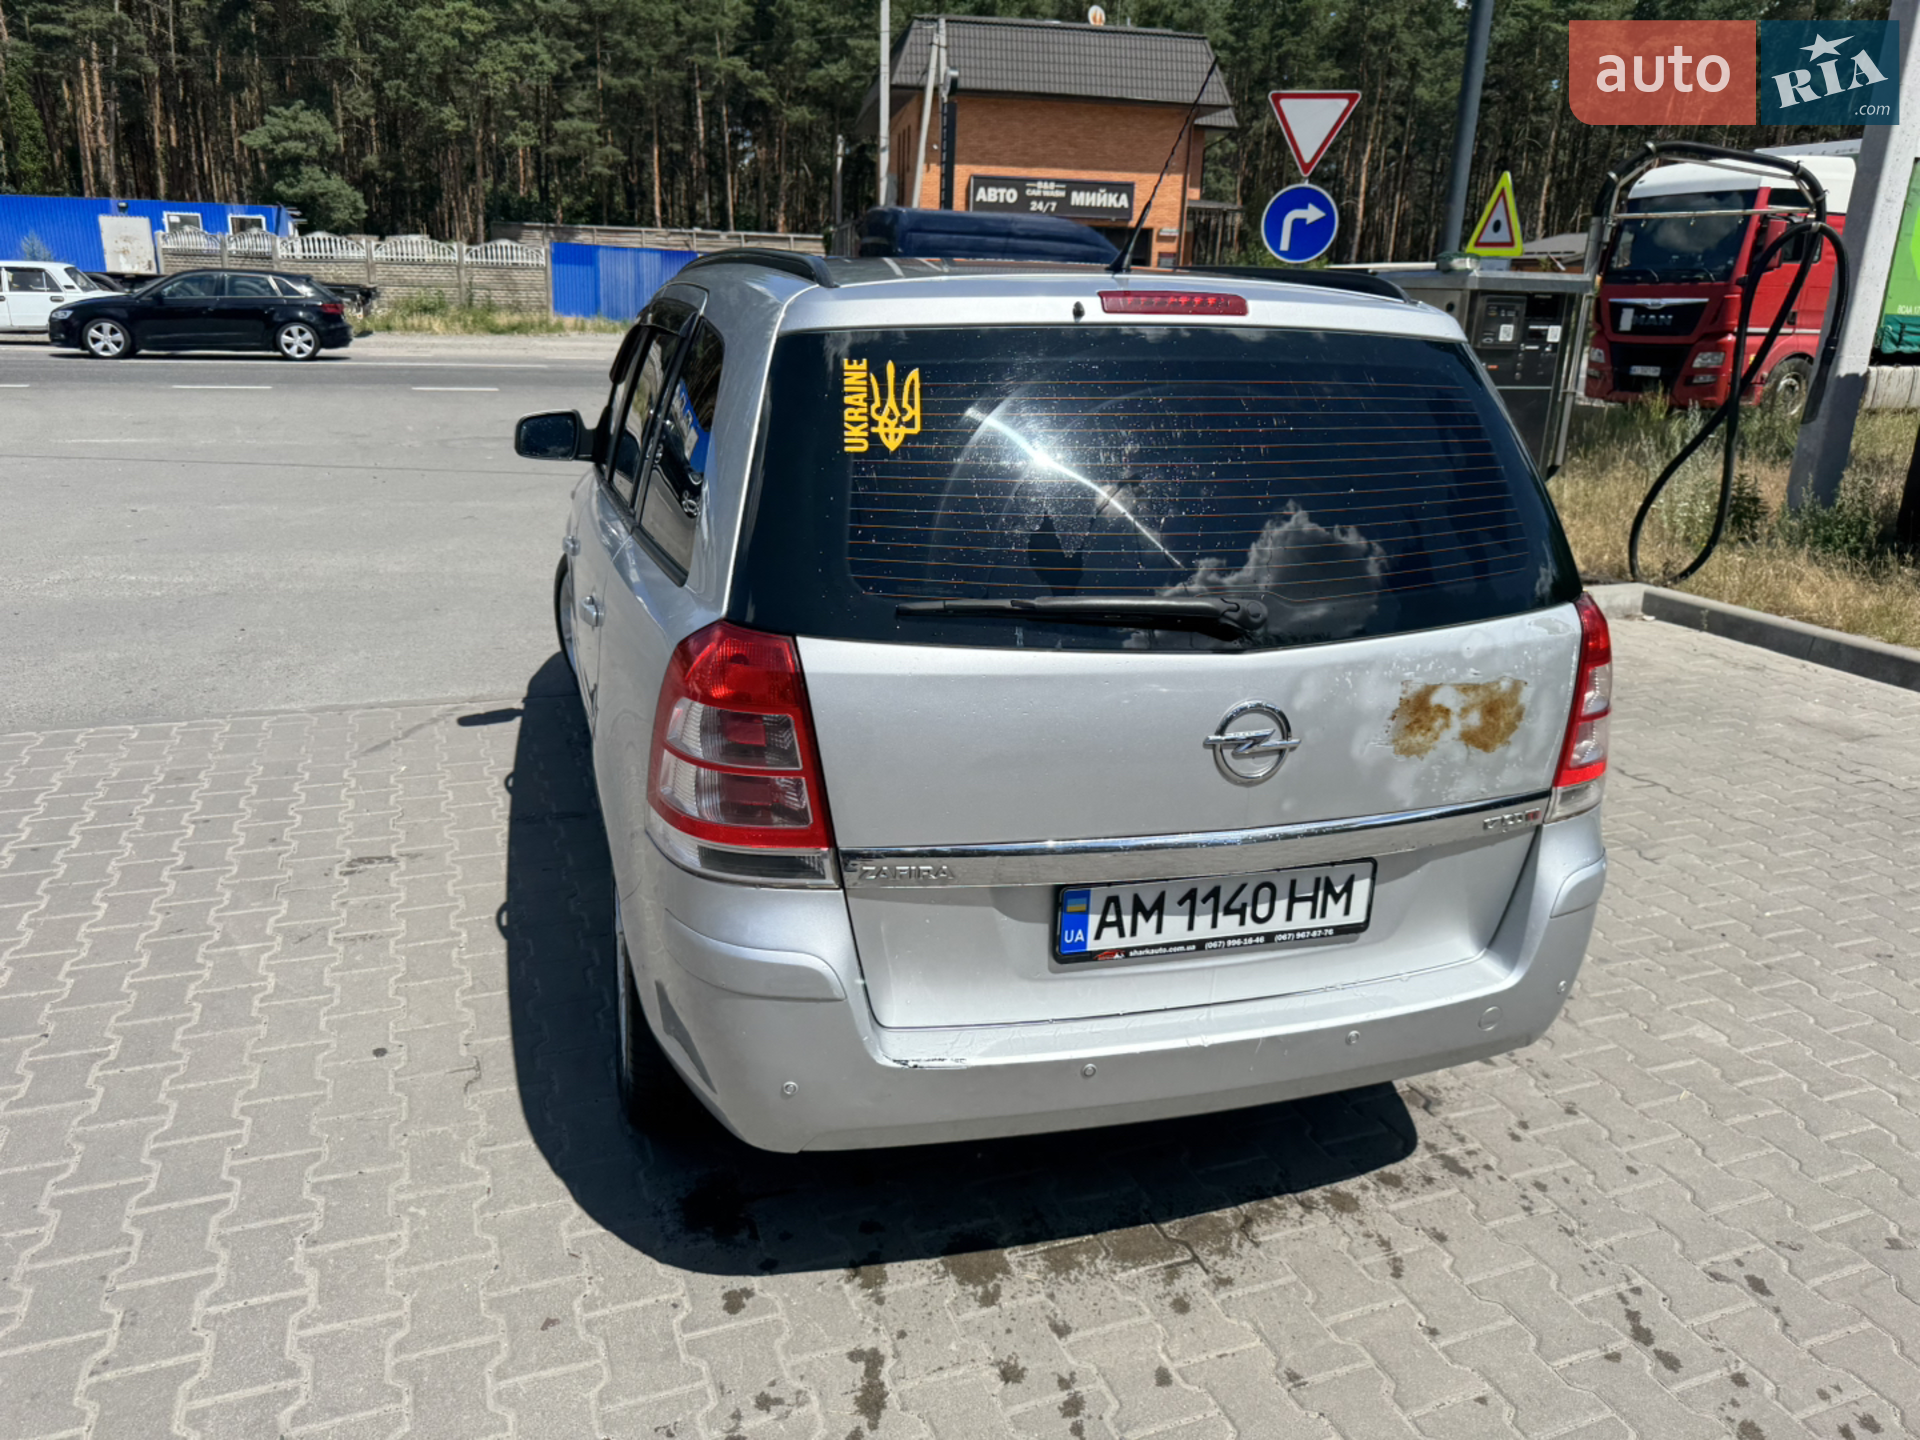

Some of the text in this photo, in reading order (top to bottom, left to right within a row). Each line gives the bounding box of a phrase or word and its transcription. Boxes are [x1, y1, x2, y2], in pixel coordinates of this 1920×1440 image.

[975, 186, 1129, 209] АВТО МИЙКА
[1029, 200, 1057, 213] 24/7
[843, 358, 869, 453] UKRAINE
[859, 865, 955, 880] ZAFIRA
[1093, 873, 1356, 941] AM 1140 HM
[1064, 928, 1085, 944] UA
[1129, 944, 1197, 957] sharkauto.com.ua
[1204, 941, 1225, 951] (067)
[1274, 933, 1295, 943] (067)
